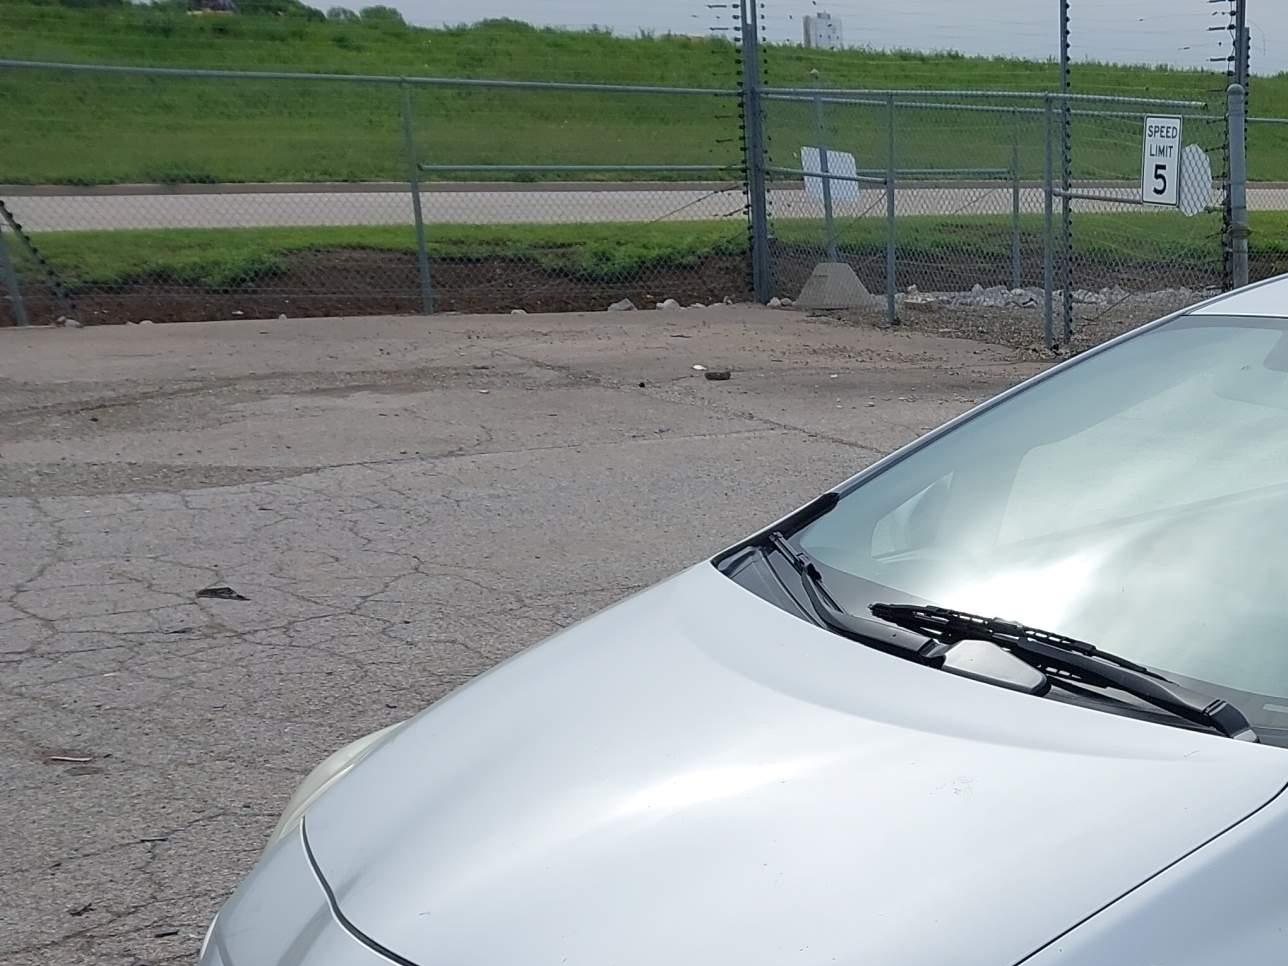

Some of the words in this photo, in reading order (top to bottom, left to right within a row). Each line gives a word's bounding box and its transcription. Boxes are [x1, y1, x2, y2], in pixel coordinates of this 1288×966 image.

[1147, 125, 1178, 139] SPEED
[1149, 144, 1174, 158] LIMIT
[1152, 163, 1167, 195] 5
